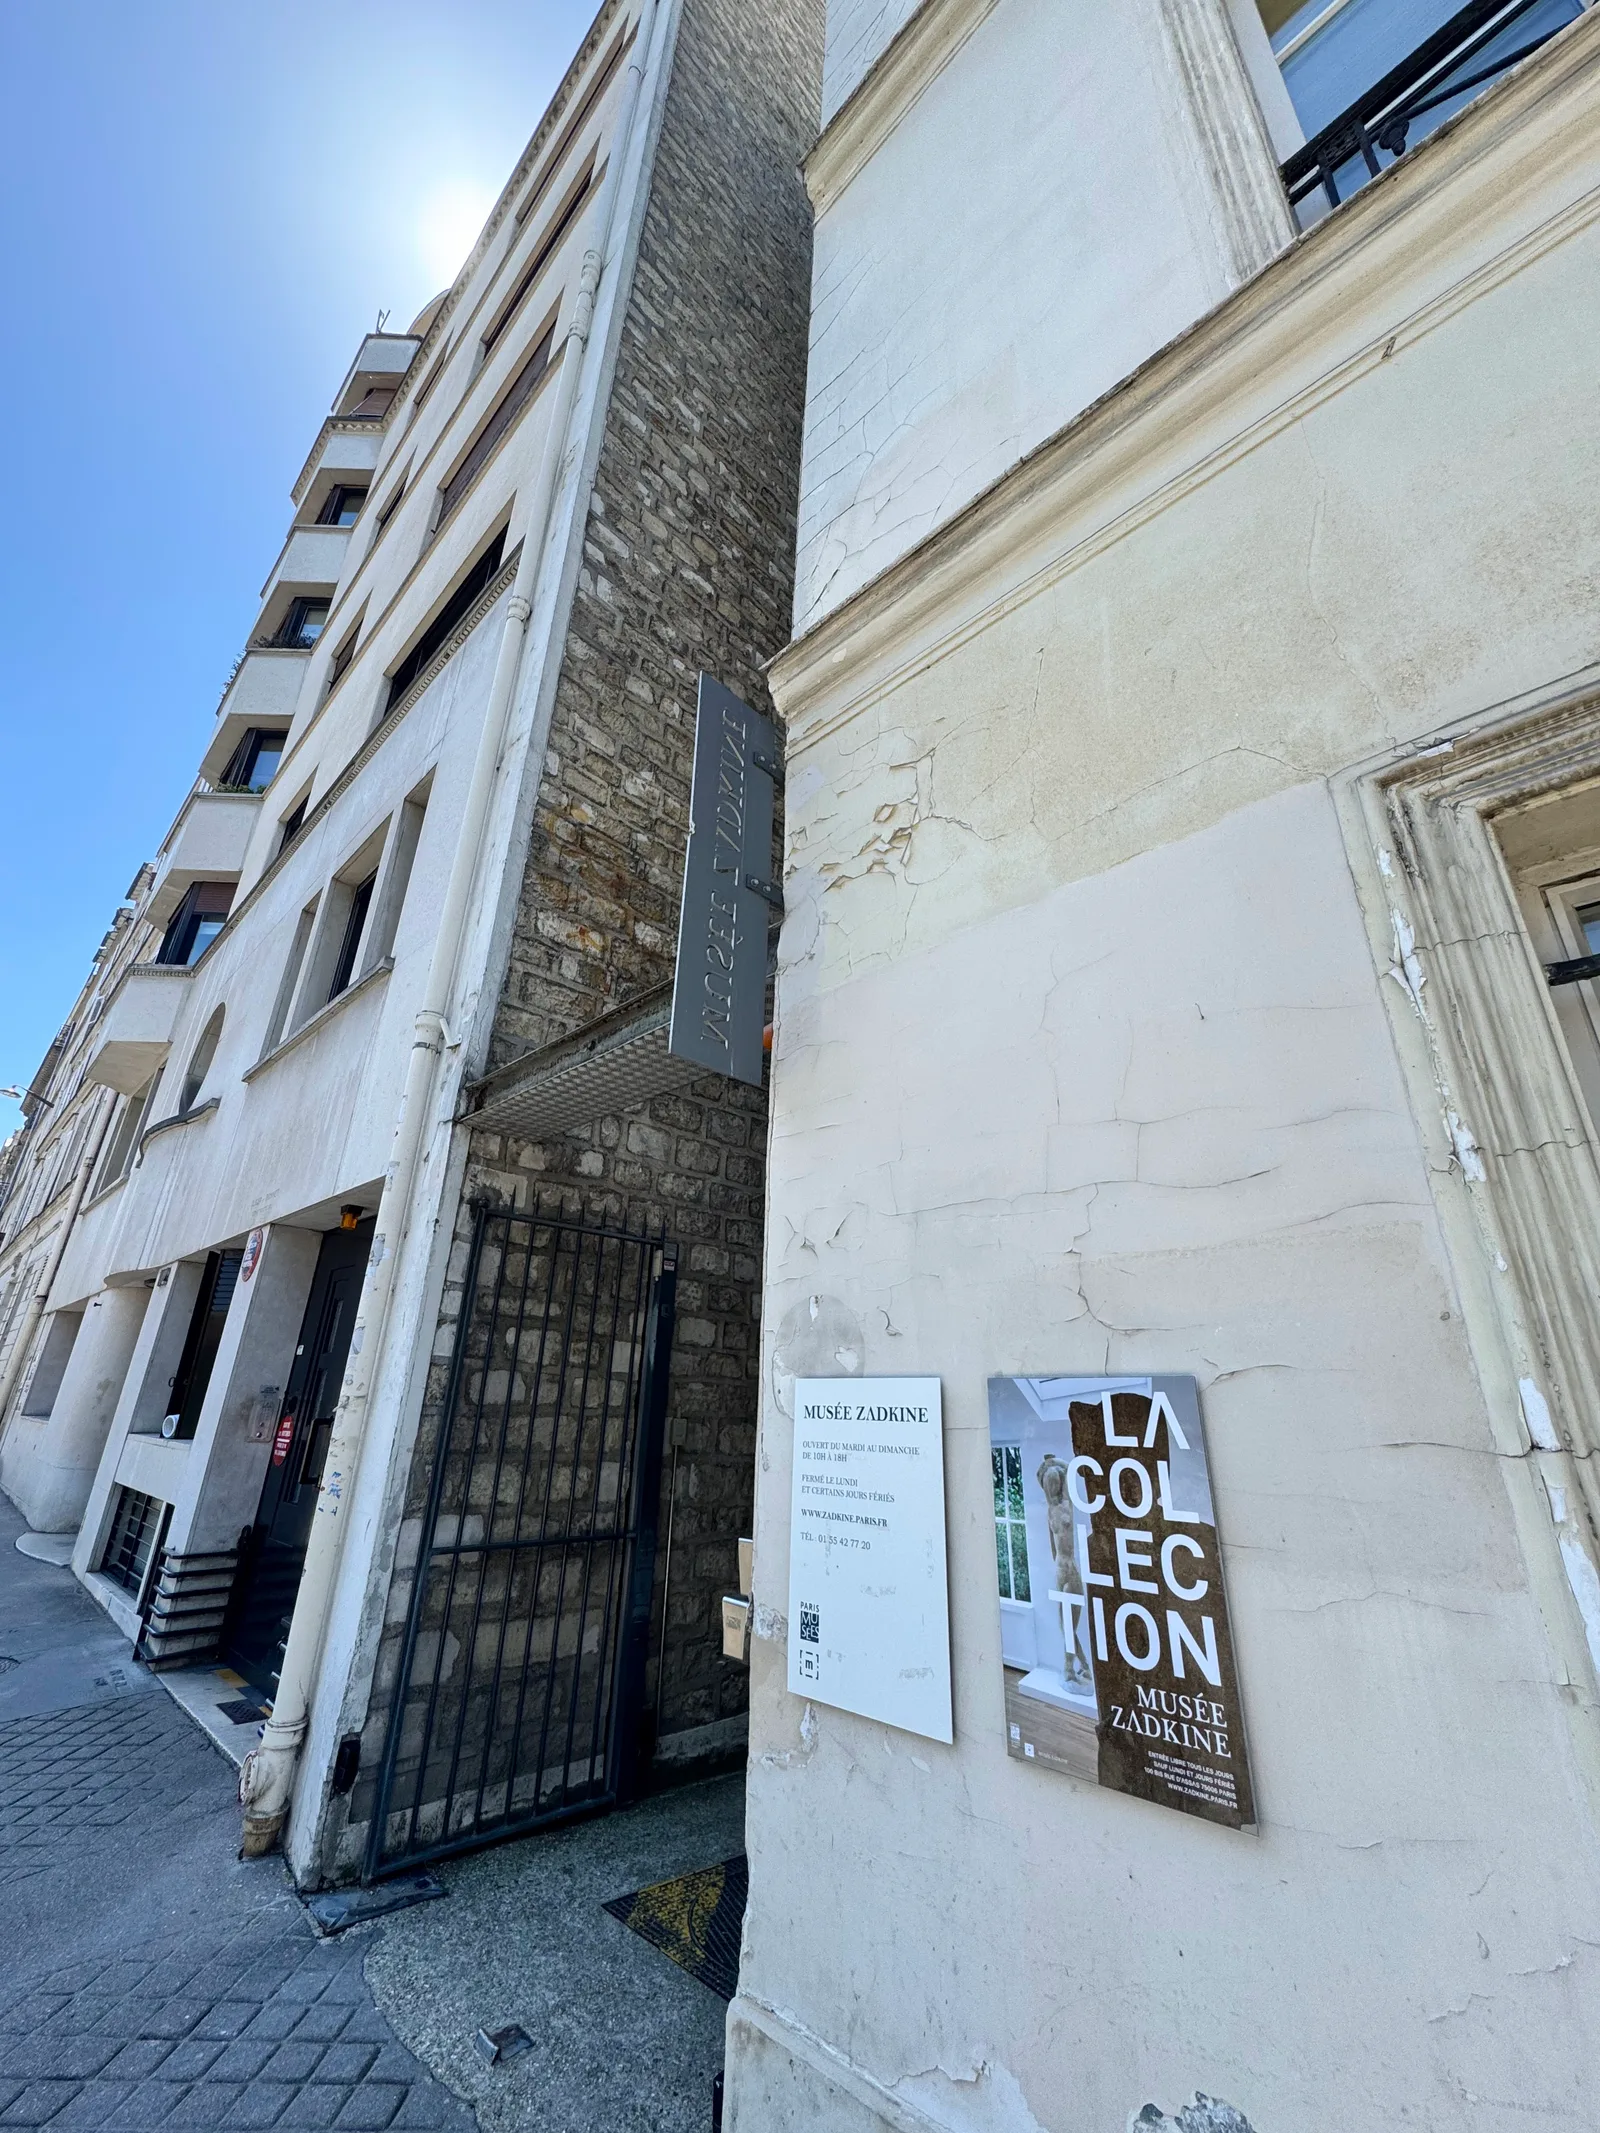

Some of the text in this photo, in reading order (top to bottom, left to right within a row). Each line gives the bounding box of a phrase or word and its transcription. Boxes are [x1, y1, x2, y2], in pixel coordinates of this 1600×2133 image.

[803, 1401, 928, 1423] MUSÉE ZADKINE
[1101, 1391, 1190, 1449] LA
[802, 1440, 920, 1456] OUVERT DU MARDI AU DIMANCHE
[802, 1452, 812, 1460] DE
[813, 1452, 826, 1461] 10H
[834, 1453, 847, 1462] 18H
[801, 1473, 858, 1487] FERMÉ LE LUNDI
[1066, 1455, 1200, 1523] COL
[801, 1485, 895, 1503] ET CERTAINS JOURS FÉRIÉS
[818, 1534, 826, 1544] 01
[829, 1536, 838, 1545] 55
[840, 1537, 849, 1547] 42
[850, 1539, 860, 1549] 77
[861, 1541, 871, 1550] 20
[1077, 1524, 1209, 1601] LEC
[800, 1601, 820, 1613] PARIS
[1048, 1589, 1222, 1687] TION
[1135, 1684, 1228, 1728] MUSÉE
[1110, 1705, 1231, 1758] ZADKINE
[1153, 1761, 1168, 1770] SAUF
[1168, 1765, 1185, 1775] LUNDI
[1186, 1770, 1194, 1778] ET
[1195, 1773, 1214, 1784] JOURS
[1170, 1757, 1186, 1767] LIBRE
[1187, 1761, 1202, 1771] TOUS
[1202, 1766, 1214, 1775] LES
[1214, 1769, 1234, 1780] JOURS
[1154, 1769, 1163, 1778] BIS
[1164, 1772, 1175, 1781] RUE
[1218, 1788, 1237, 1799] PARIS
